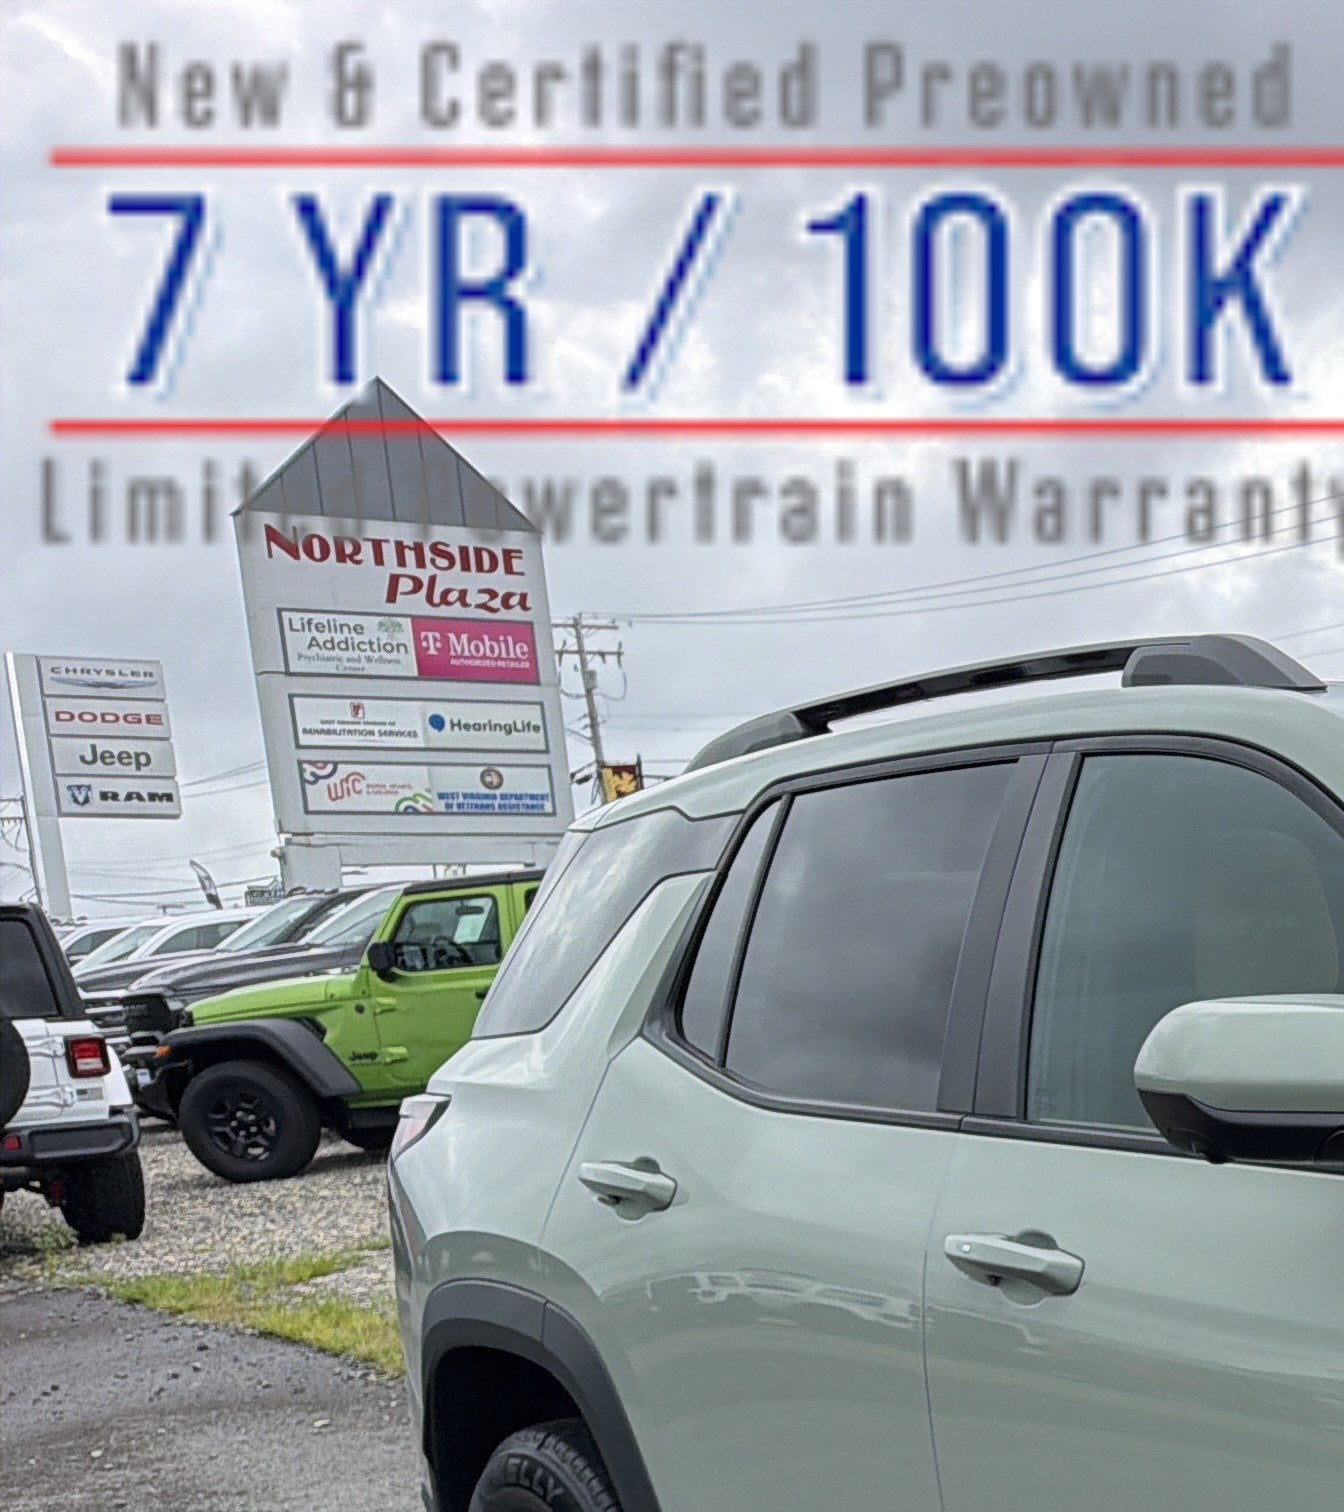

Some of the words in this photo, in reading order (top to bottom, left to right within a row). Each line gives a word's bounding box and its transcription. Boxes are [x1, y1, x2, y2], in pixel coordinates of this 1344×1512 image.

[264, 524, 526, 576] NORTHSIDE
[385, 573, 532, 613] Plaza
[288, 616, 365, 636] Lifeline
[307, 636, 409, 655] Addiction
[447, 632, 530, 660] Mobile
[50, 666, 154, 679] CHRYSLER
[54, 710, 163, 726] DODGE
[449, 718, 541, 736] HearingLife
[79, 743, 151, 771] Jeep
[99, 790, 174, 803] RAM
